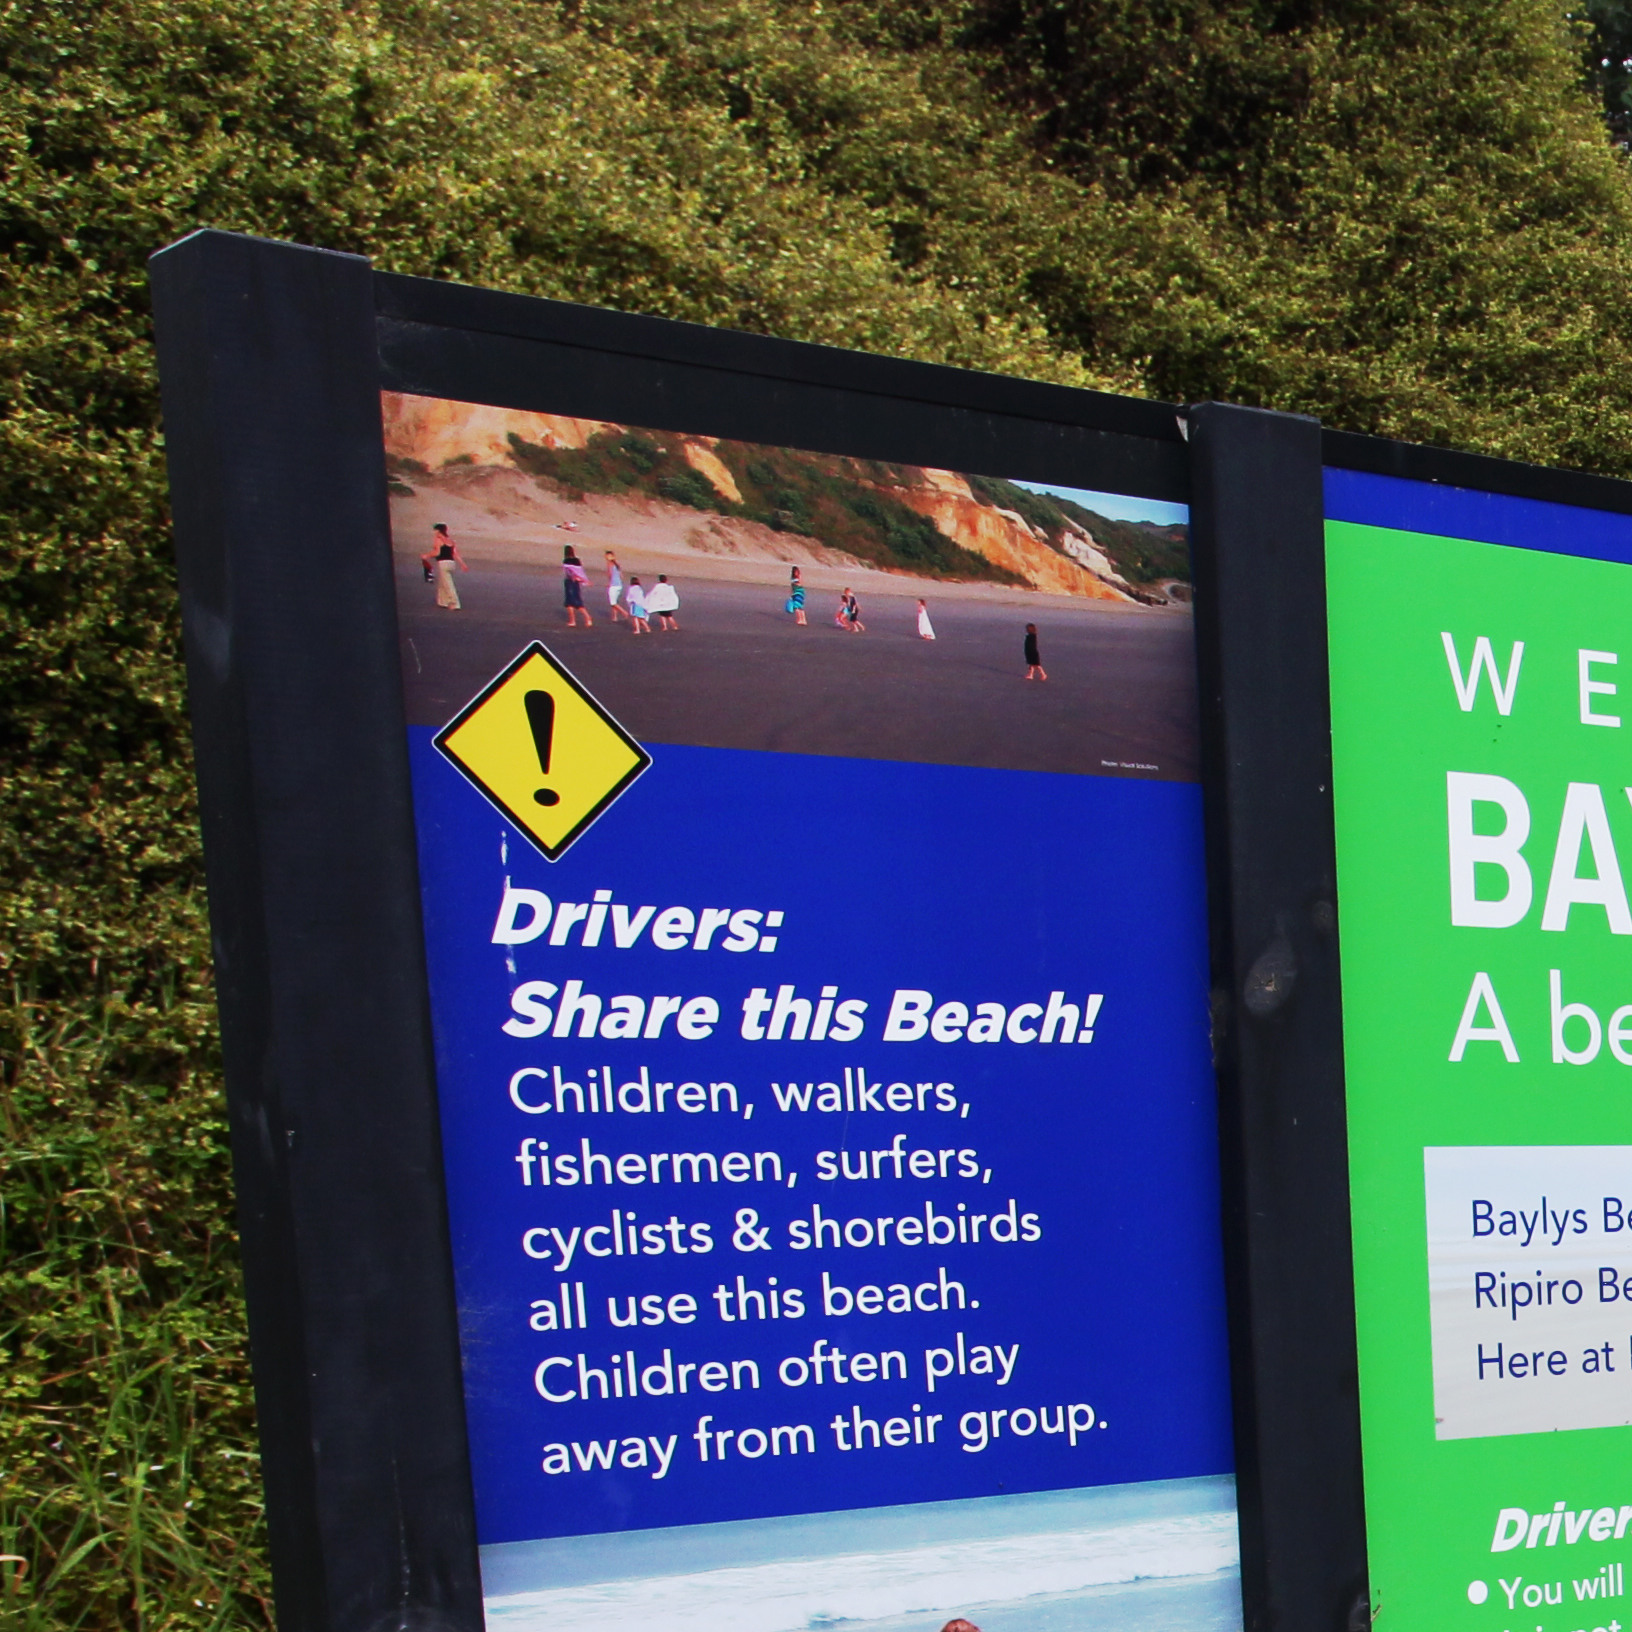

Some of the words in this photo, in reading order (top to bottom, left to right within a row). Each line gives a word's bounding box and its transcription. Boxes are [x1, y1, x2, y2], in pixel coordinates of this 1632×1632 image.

[492, 889, 784, 952] Drivers:
[502, 980, 718, 1039] Share
[741, 985, 867, 1041] this
[883, 990, 1103, 1043] Beach!
[1448, 972, 1520, 1062] A
[510, 1066, 753, 1119] Children,
[772, 1067, 969, 1117] walkers,
[515, 1138, 796, 1187] fishermen,
[817, 1134, 991, 1183] surfers,
[523, 1210, 713, 1271] cyclists
[733, 1208, 771, 1251] &
[789, 1199, 1040, 1249] shorebirds
[1473, 1196, 1587, 1246] Baylys
[530, 1282, 586, 1331] all
[608, 1294, 696, 1327] use
[713, 1276, 804, 1321] this
[823, 1267, 979, 1315] beach.
[1476, 1270, 1582, 1320] Ripiro
[535, 1349, 759, 1402] Children
[779, 1340, 906, 1386] often
[926, 1332, 1019, 1392] play
[543, 1435, 677, 1479] away
[694, 1416, 814, 1461] from
[831, 1404, 942, 1450] their
[960, 1404, 1107, 1452] group.
[1499, 1577, 1562, 1609] You
[1573, 1563, 1623, 1601] will
